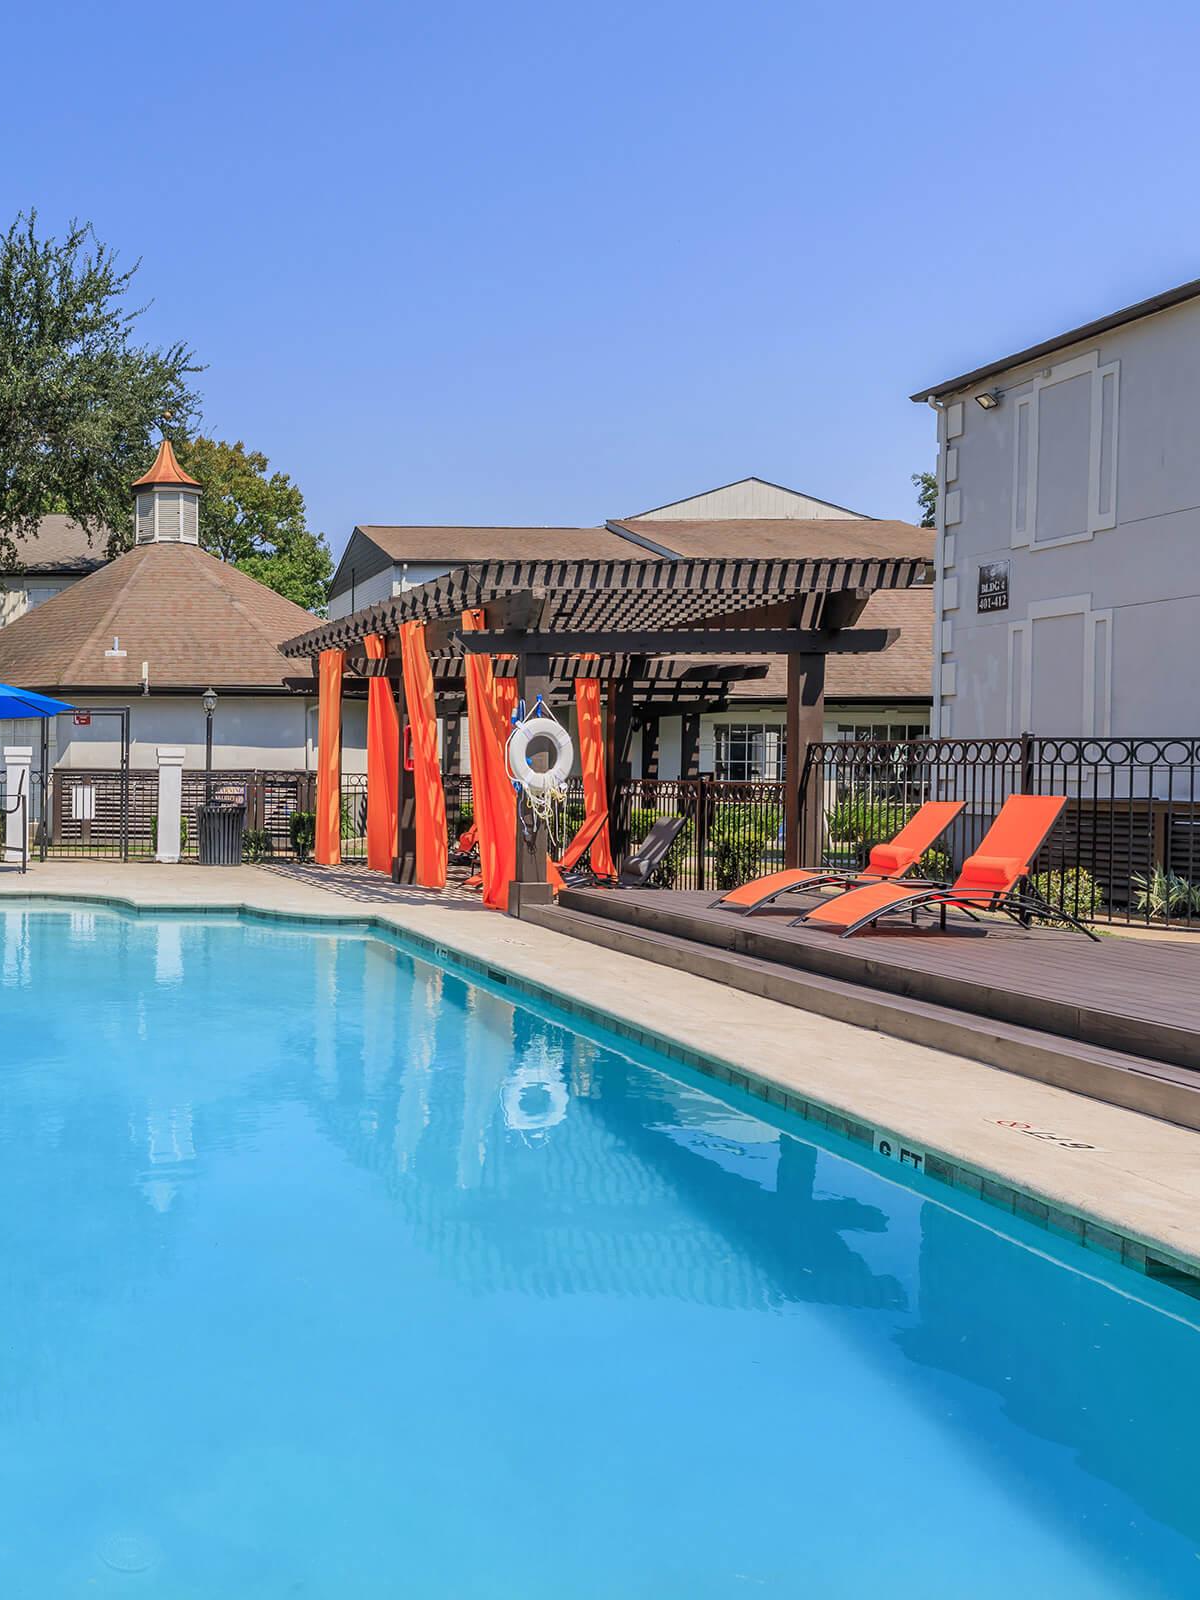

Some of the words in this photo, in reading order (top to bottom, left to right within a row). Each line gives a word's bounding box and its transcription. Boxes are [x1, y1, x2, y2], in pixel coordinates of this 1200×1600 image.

[981, 581, 1000, 593] BLDG
[979, 594, 1007, 609] 401-412
[900, 1148, 922, 1169] FT
